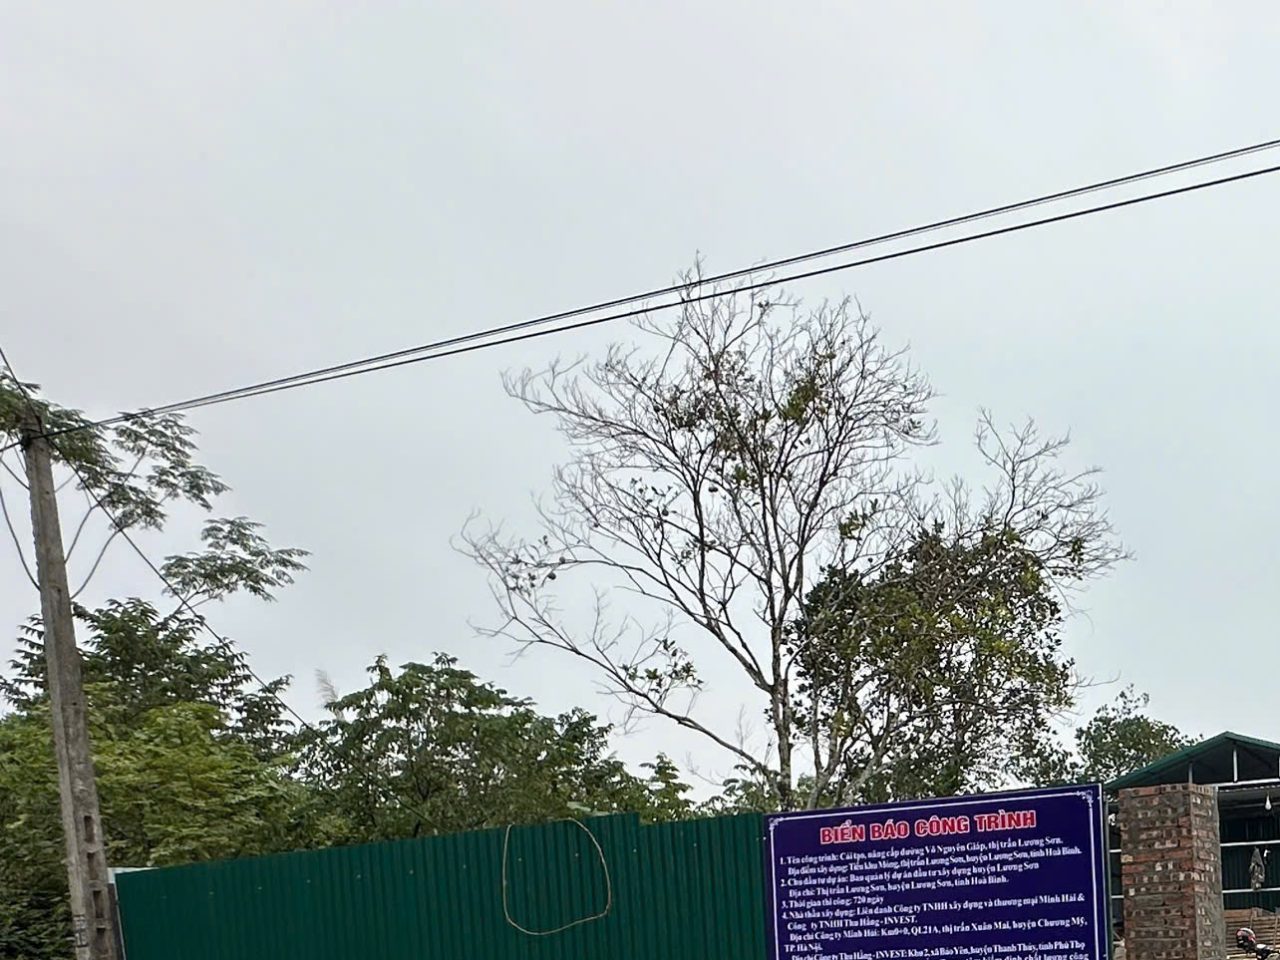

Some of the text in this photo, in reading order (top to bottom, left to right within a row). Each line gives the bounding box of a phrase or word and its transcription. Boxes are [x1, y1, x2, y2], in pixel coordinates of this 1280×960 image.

[820, 809, 1036, 844] BIỂN BÁO CÔNG TRÌNH
[996, 861, 1023, 873] Lương
[1023, 861, 1039, 869] Sơn
[1077, 892, 1084, 901] &
